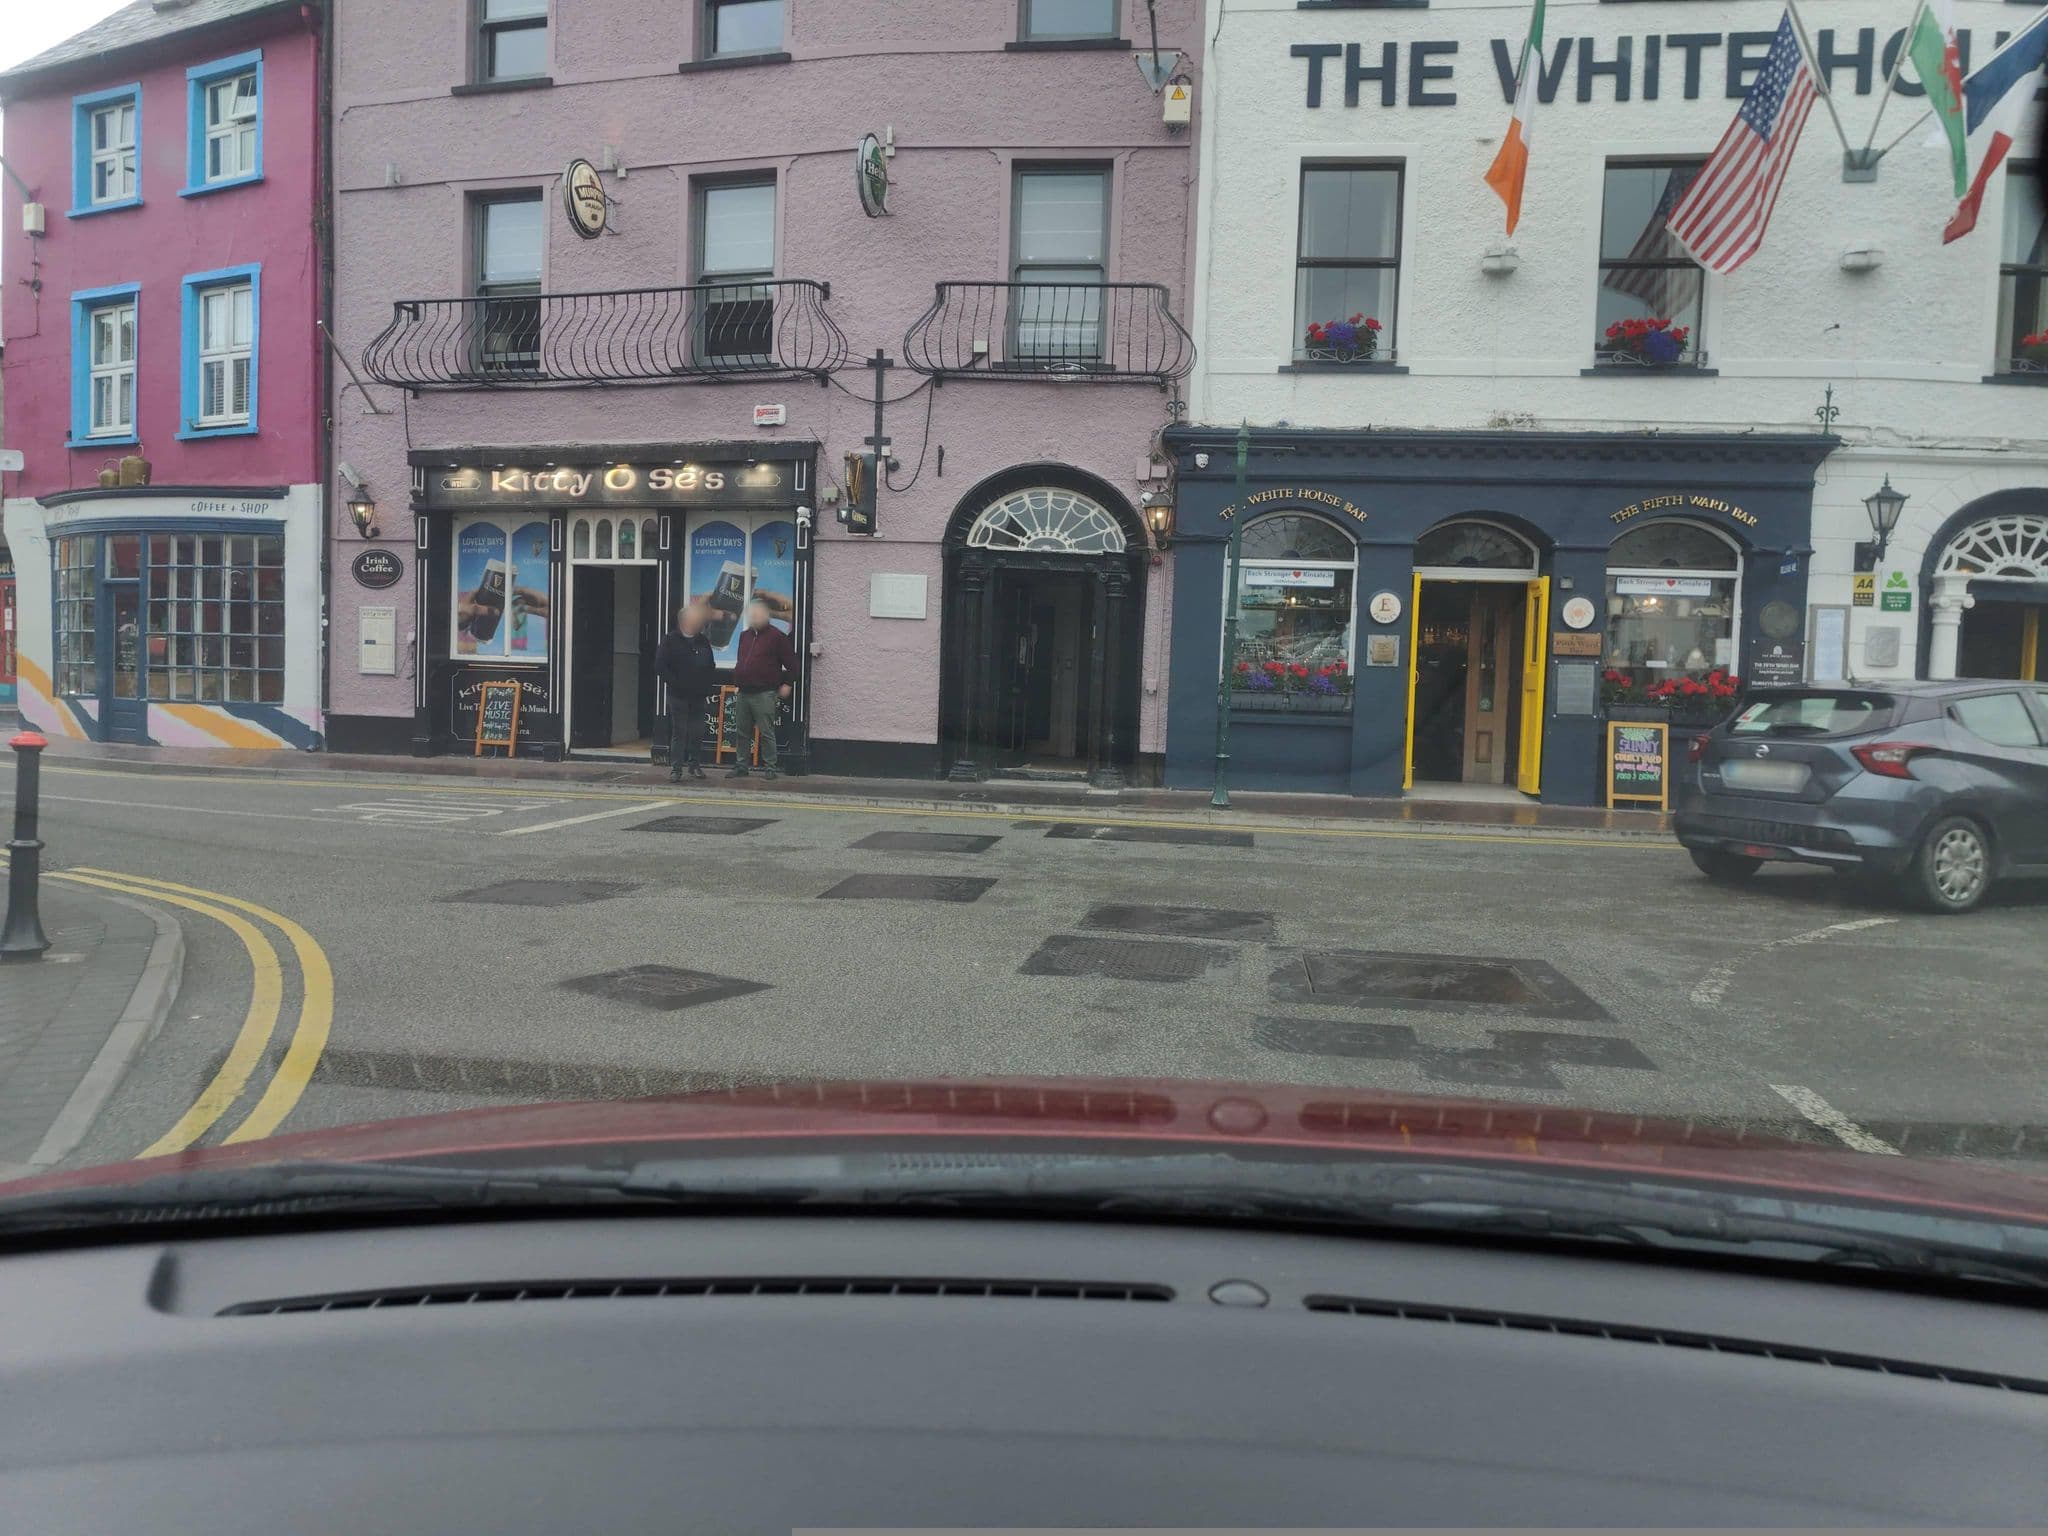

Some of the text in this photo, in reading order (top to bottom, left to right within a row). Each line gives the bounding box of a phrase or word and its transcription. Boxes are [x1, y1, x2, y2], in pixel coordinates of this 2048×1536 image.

[1289, 40, 1459, 108] THE
[1490, 31, 1780, 105] WHITE
[191, 502, 227, 513] COFFEE
[241, 502, 270, 515] SHOP
[1219, 488, 1369, 523] TH WHITE HOUSE BAR
[1610, 494, 1758, 528] THE FIFTH WARD BAR
[695, 537, 743, 547] LOVELY DAYS
[365, 556, 389, 565] Irish
[361, 564, 394, 573] Coffee
[1857, 578, 1874, 589] AA
[1379, 598, 1391, 612] E
[459, 702, 473, 711] Live
[528, 704, 548, 713] Music
[485, 700, 513, 711] LIVE
[484, 710, 512, 720] MUSIC
[1619, 739, 1660, 754] SUNNY
